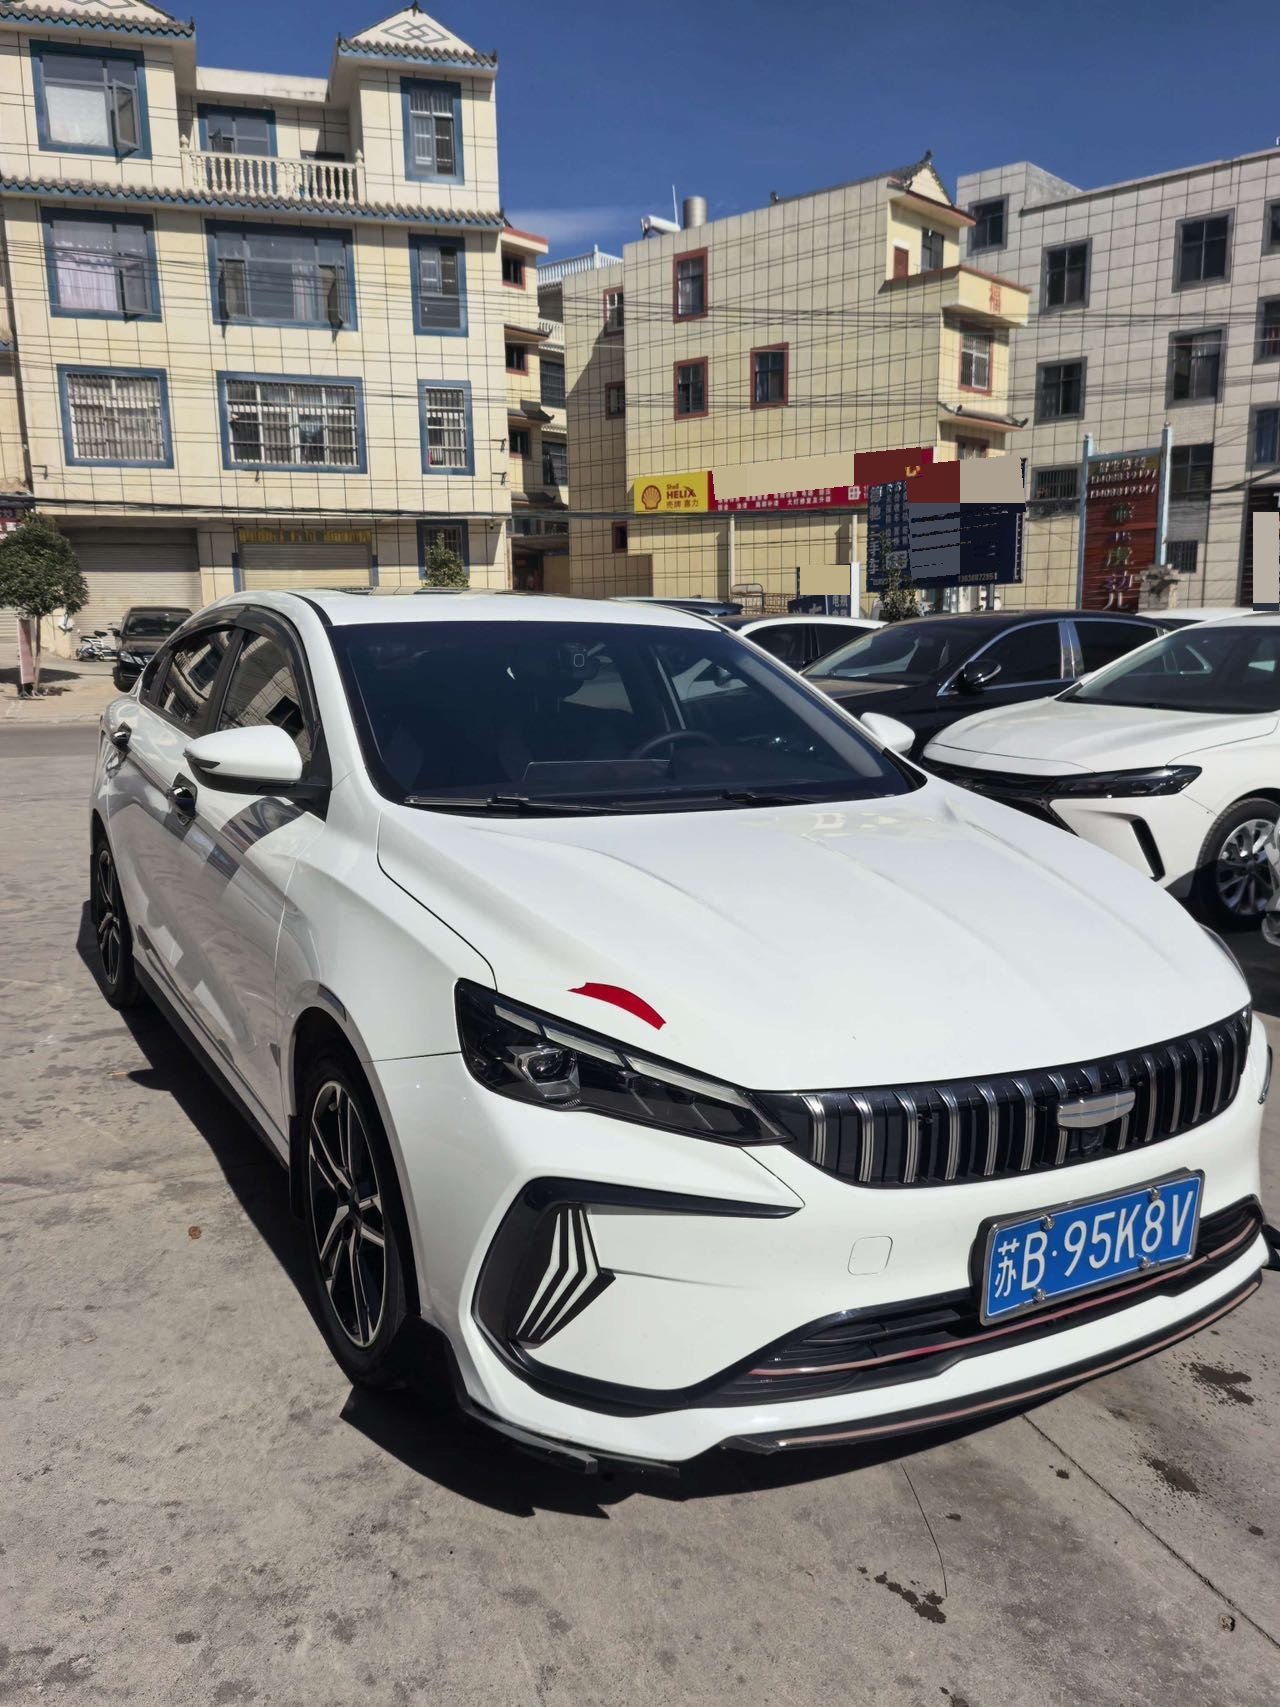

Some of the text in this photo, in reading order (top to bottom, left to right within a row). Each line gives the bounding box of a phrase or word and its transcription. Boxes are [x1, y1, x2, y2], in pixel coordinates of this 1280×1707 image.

[666, 486, 697, 499] HELIX
[666, 499, 699, 509] 壳牌 喜力
[995, 1190, 1194, 1298] 苏B·95K8V
